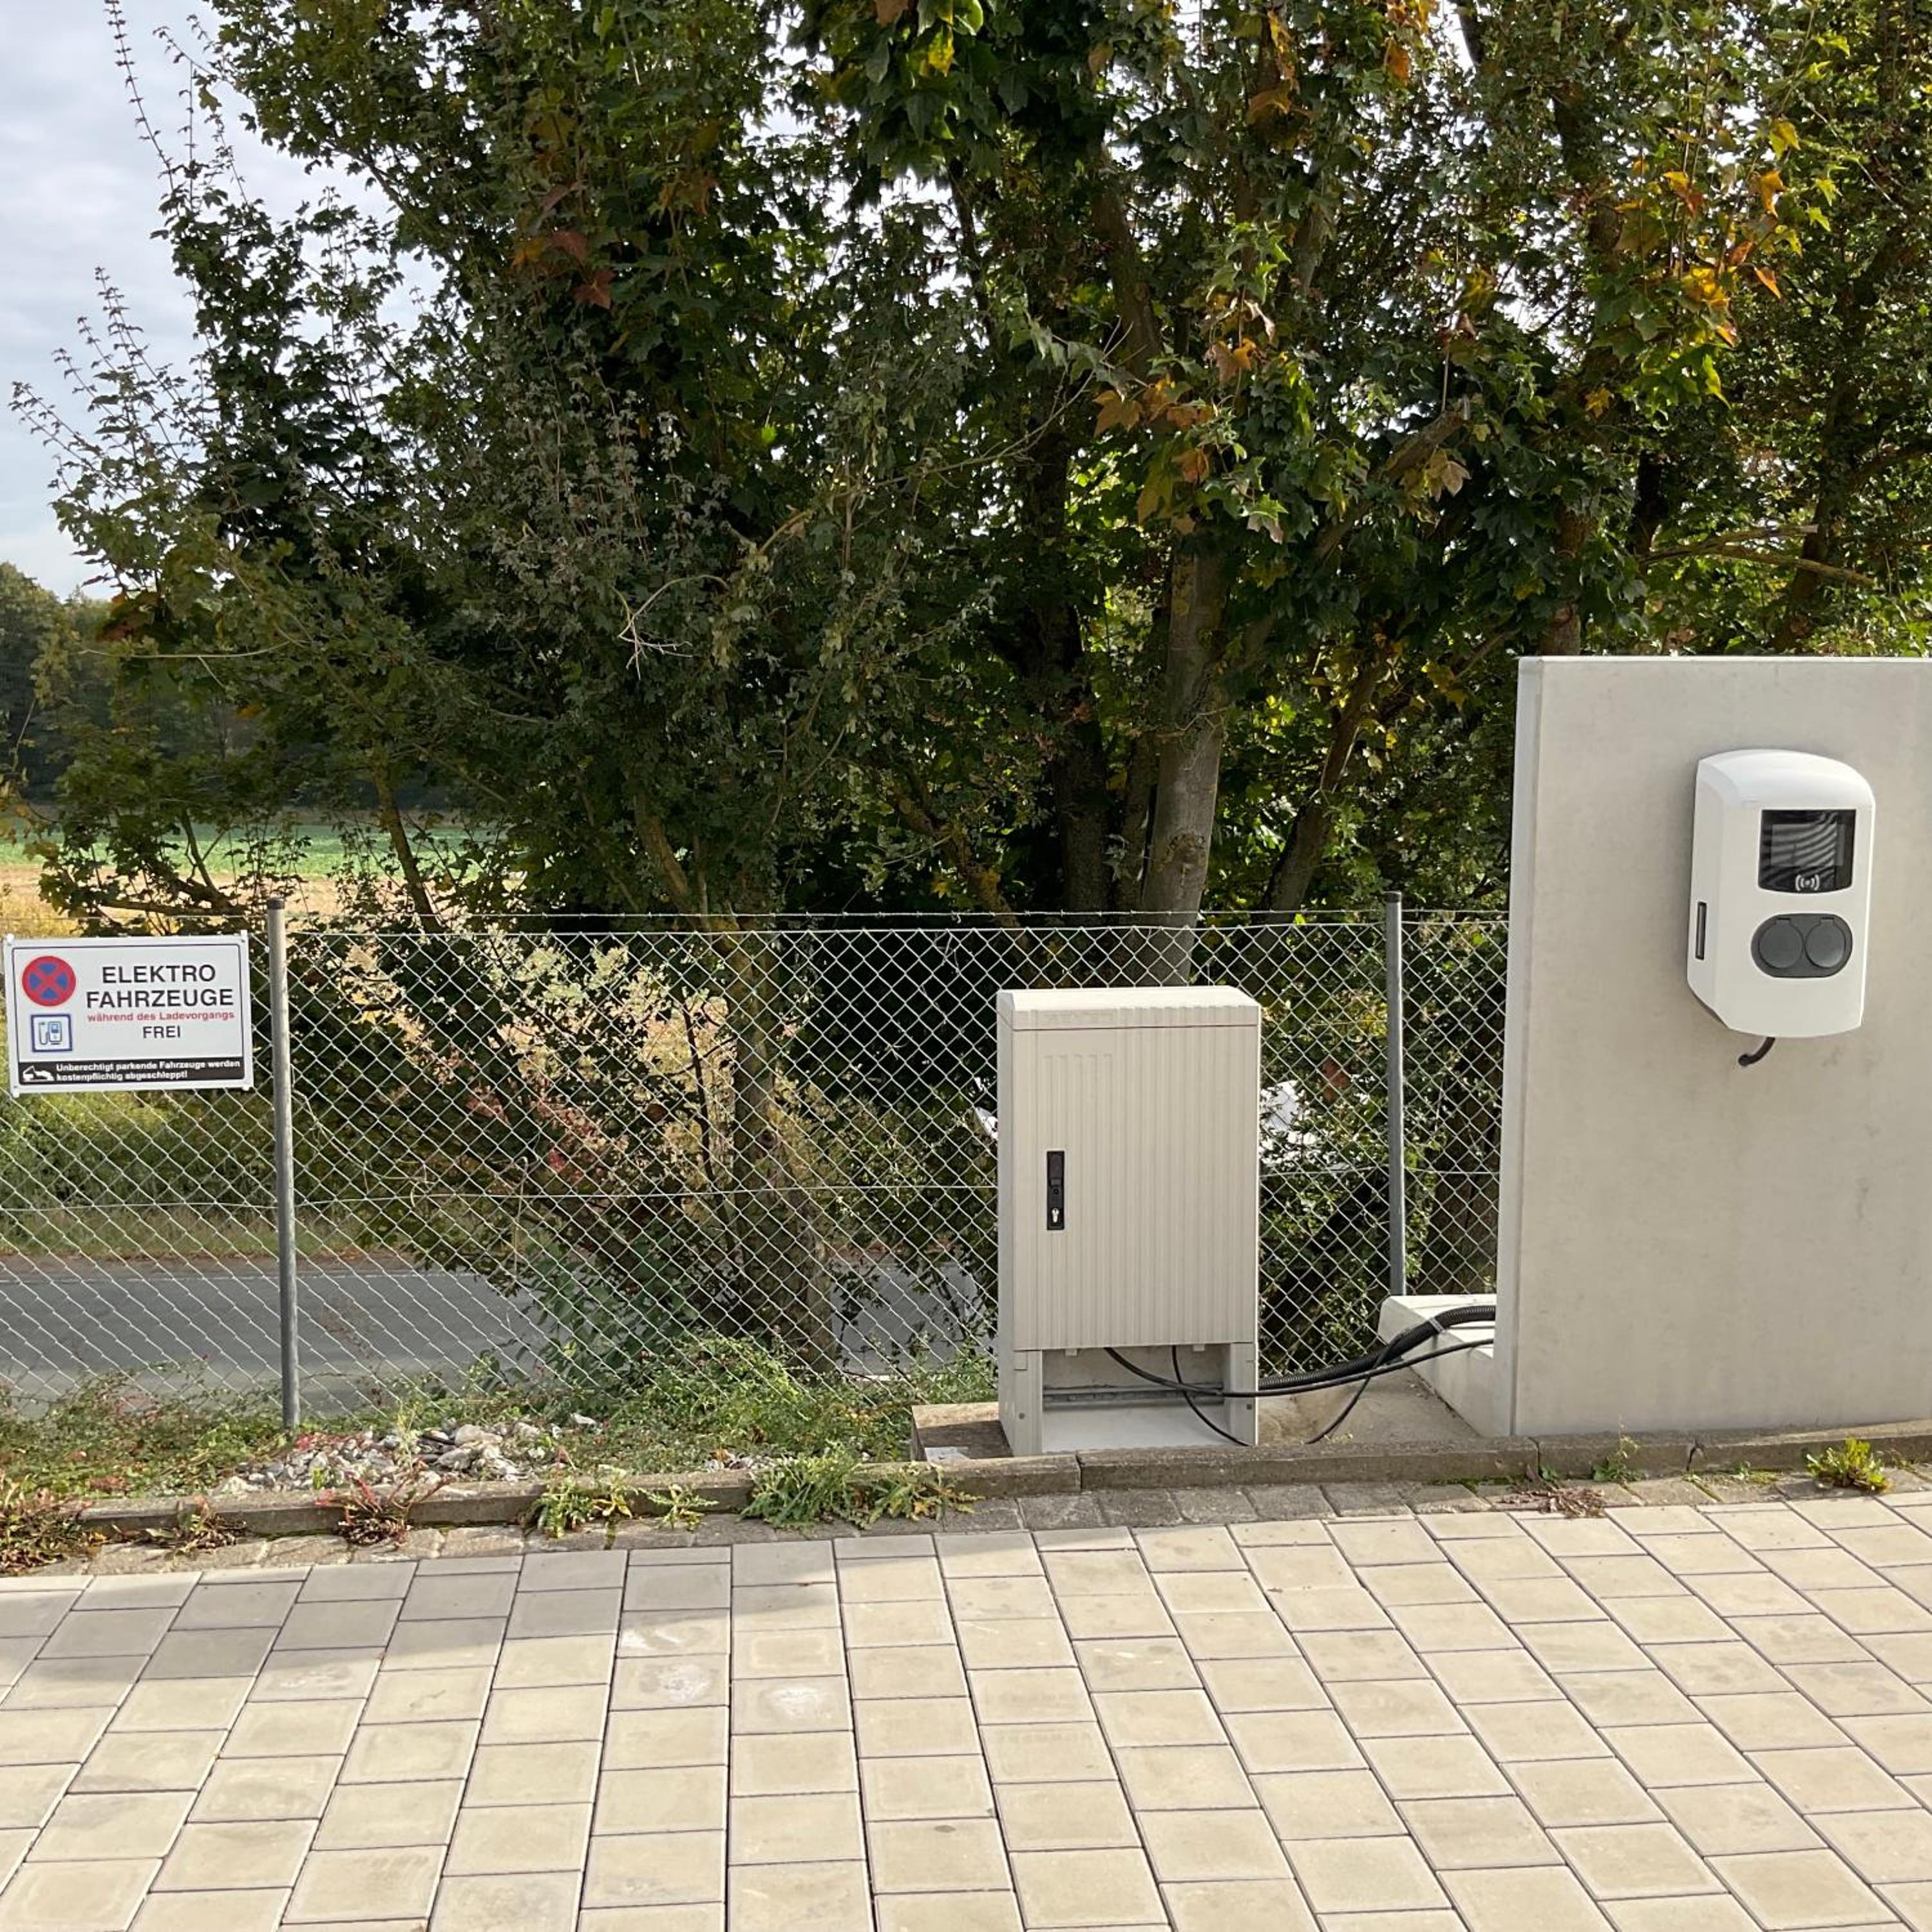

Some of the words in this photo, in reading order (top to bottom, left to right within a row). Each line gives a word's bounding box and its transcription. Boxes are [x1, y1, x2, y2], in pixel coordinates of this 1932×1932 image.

[102, 965, 216, 983] ELEKTRO
[86, 989, 234, 1009] FAHRZEUGE
[88, 1014, 133, 1022] während
[159, 1010, 235, 1022] Ladevorgangs
[142, 1025, 181, 1039] FREI
[56, 1063, 114, 1072] Unberechtigt
[116, 1062, 156, 1072] parkende
[159, 1061, 205, 1070] Fahrzeuge
[56, 1071, 123, 1082] kostenpflichtig
[125, 1070, 187, 1081] abgeschleppt!
